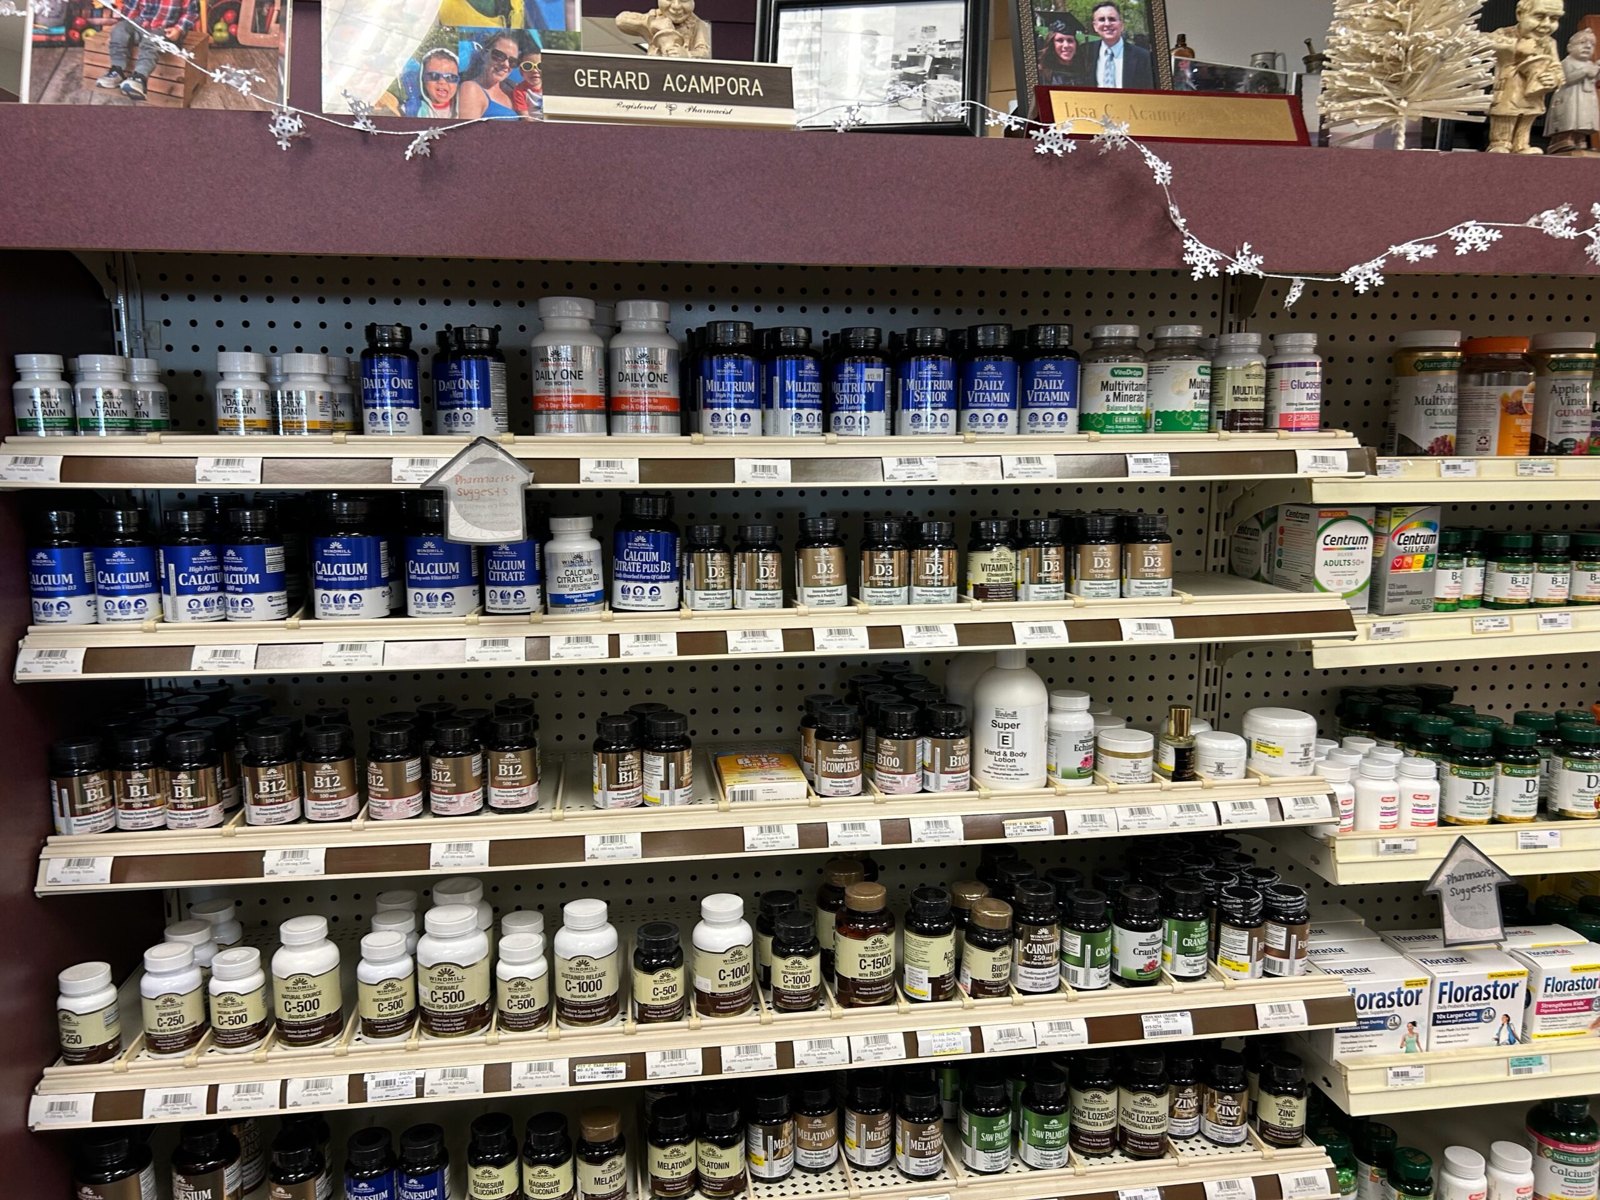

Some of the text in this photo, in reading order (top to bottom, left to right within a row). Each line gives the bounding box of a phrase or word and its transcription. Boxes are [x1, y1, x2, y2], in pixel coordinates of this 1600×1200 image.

[574, 69, 764, 97] GERARD ACAMPORA
[616, 101, 734, 117] Registered Pharmacist
[1064, 100, 1096, 118] Lisa
[535, 368, 584, 381] DAILY ONE
[617, 371, 669, 383] DAILY ONE
[363, 377, 413, 390] DAILY ONE
[457, 378, 480, 390] ONE
[705, 379, 755, 393] MILLTRIUM
[785, 380, 822, 393] MILLTRI
[906, 378, 954, 391] MILLTRIUM
[973, 378, 1005, 391] DAILY
[1033, 378, 1064, 390] DAILY
[913, 390, 947, 402] SENIOR
[1026, 390, 1070, 402] VITAMIN
[1232, 385, 1253, 396] MULTI
[1550, 384, 1581, 397] Apple
[835, 392, 867, 405] SENIOR
[967, 391, 1010, 404] VITAMIN
[1105, 392, 1145, 403] & Minerals
[1414, 395, 1458, 407] Multivita
[95, 400, 122, 409] DAILY
[90, 408, 128, 417] VITAMIN
[454, 474, 517, 486] Pharmacist
[1285, 508, 1310, 521] Centrum
[1236, 525, 1260, 538] entrum
[1323, 534, 1369, 547] Centrum
[1397, 532, 1437, 546] Centrum
[1403, 545, 1430, 553] SILVER
[623, 549, 659, 562] CALCIUM
[315, 561, 368, 575] CALCIUM
[408, 560, 460, 574] CALCIUM
[487, 559, 526, 571] CALCIUM
[614, 561, 671, 573] CITRATE PLUS D3
[817, 562, 834, 574] D3
[980, 562, 1008, 573] VITAMIN
[1042, 560, 1060, 572] D3
[1093, 557, 1111, 569] D3
[1144, 556, 1162, 568] D3
[1323, 559, 1351, 567] ADULTS
[488, 570, 525, 581] CITRATE
[564, 569, 593, 577] CALCIUM
[708, 566, 725, 578] D3
[759, 566, 776, 578] D3
[874, 564, 893, 577] D3
[925, 564, 943, 576] D3
[97, 570, 150, 584] CALCIUM
[556, 573, 600, 584] CITRATE D3
[1511, 576, 1530, 585] B-12
[1551, 576, 1569, 585] B-12
[991, 719, 1021, 730] Super
[1001, 735, 1010, 746] E
[984, 748, 1028, 760] Hand & Body
[826, 760, 854, 773] COMPLEX
[876, 753, 900, 768] B100
[949, 753, 970, 768] B100
[1572, 761, 1598, 771] NATURE'S
[431, 768, 451, 782] B12
[498, 763, 523, 777] B12
[1458, 768, 1485, 777] NATURE'S
[1512, 767, 1535, 776] NATURE'S
[313, 775, 341, 789] B12
[367, 773, 384, 787] B12
[618, 770, 639, 785] B12
[129, 785, 150, 798] B1
[174, 785, 193, 799] B1
[258, 779, 287, 793] B12
[1472, 781, 1490, 796] D3
[86, 786, 105, 803] B1
[1445, 869, 1496, 885] Pharmacist
[859, 956, 892, 970] C-1500
[1419, 955, 1468, 966] Florastor
[586, 970, 607, 979] RELEASE
[718, 963, 751, 980] C-1000
[1323, 966, 1371, 976] Florastor
[428, 975, 467, 983] WINDMILL
[782, 973, 811, 985] C-1000
[564, 978, 603, 993] C-1000
[652, 983, 678, 997] C-500
[302, 991, 323, 999] SOURCE
[430, 989, 466, 1004] C-500
[1438, 980, 1520, 1005] Florastor
[284, 997, 320, 1013] C-500
[377, 998, 404, 1013] C-500
[506, 997, 536, 1010] C-500
[1541, 1001, 1573, 1009] Strengthens
[156, 1014, 185, 1027] C-250
[217, 1013, 248, 1026] C-500
[1447, 1012, 1465, 1020] Larger
[1175, 1097, 1198, 1109] ZINC
[1072, 1106, 1117, 1121] ZINC LOZENGES
[1121, 1107, 1167, 1124] ZINC LOZENGES
[1215, 1103, 1241, 1116] ZINC
[1278, 1109, 1296, 1117] ZINC
[797, 1128, 835, 1141] MELATONIN
[980, 1132, 993, 1141] SAW
[1032, 1130, 1045, 1139] SAW
[1554, 1153, 1583, 1163] NATURE'S
[657, 1159, 692, 1170] MELATONIN
[1550, 1166, 1591, 1179] Calcium
[472, 1180, 504, 1188] MAGNESIUM
[528, 1180, 560, 1189] MAGNESIUM
[473, 1186, 504, 1195] GLUCONATE
[529, 1186, 560, 1195] GLUCONATE
